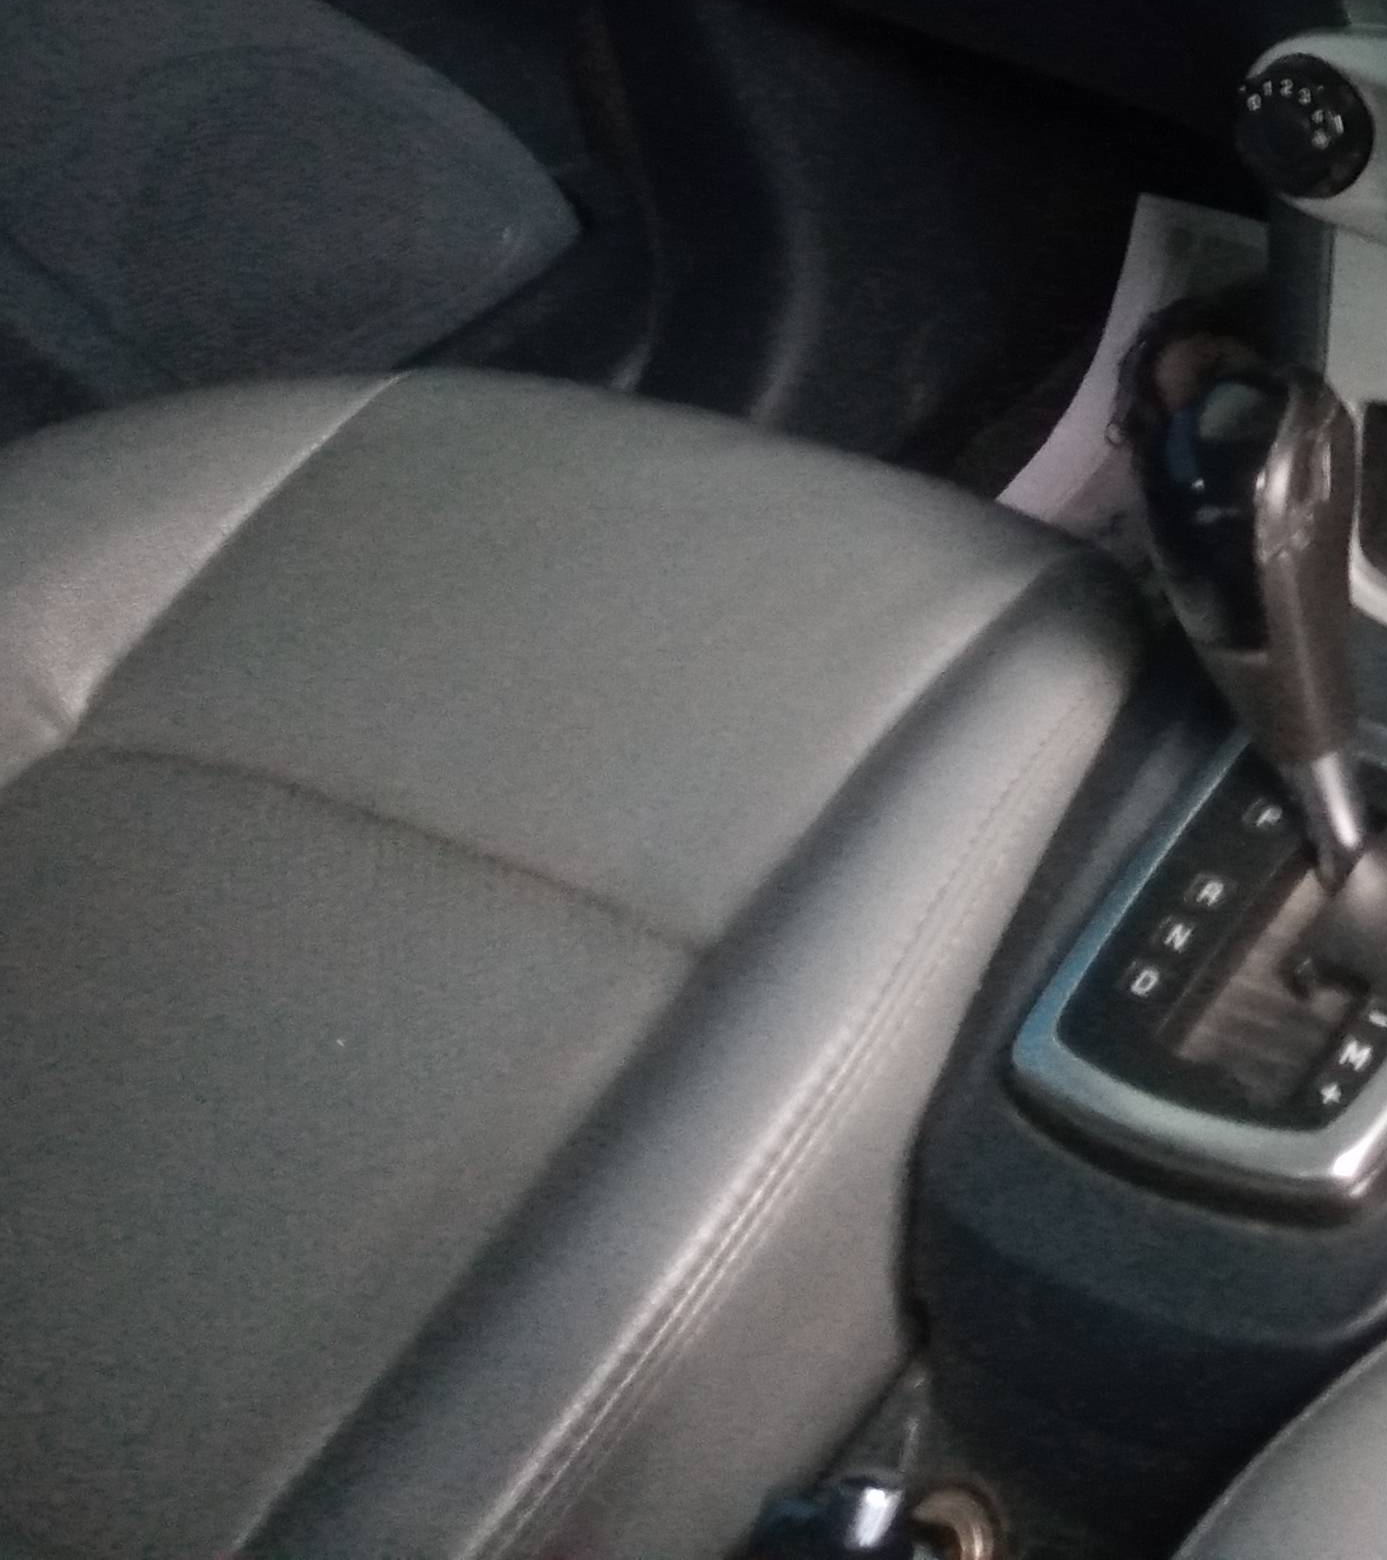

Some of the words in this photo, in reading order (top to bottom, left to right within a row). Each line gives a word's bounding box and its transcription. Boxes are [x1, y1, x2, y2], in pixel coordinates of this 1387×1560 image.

[1163, 923, 1193, 953] N
[1131, 968, 1160, 998] D
[1338, 1040, 1372, 1072] M
